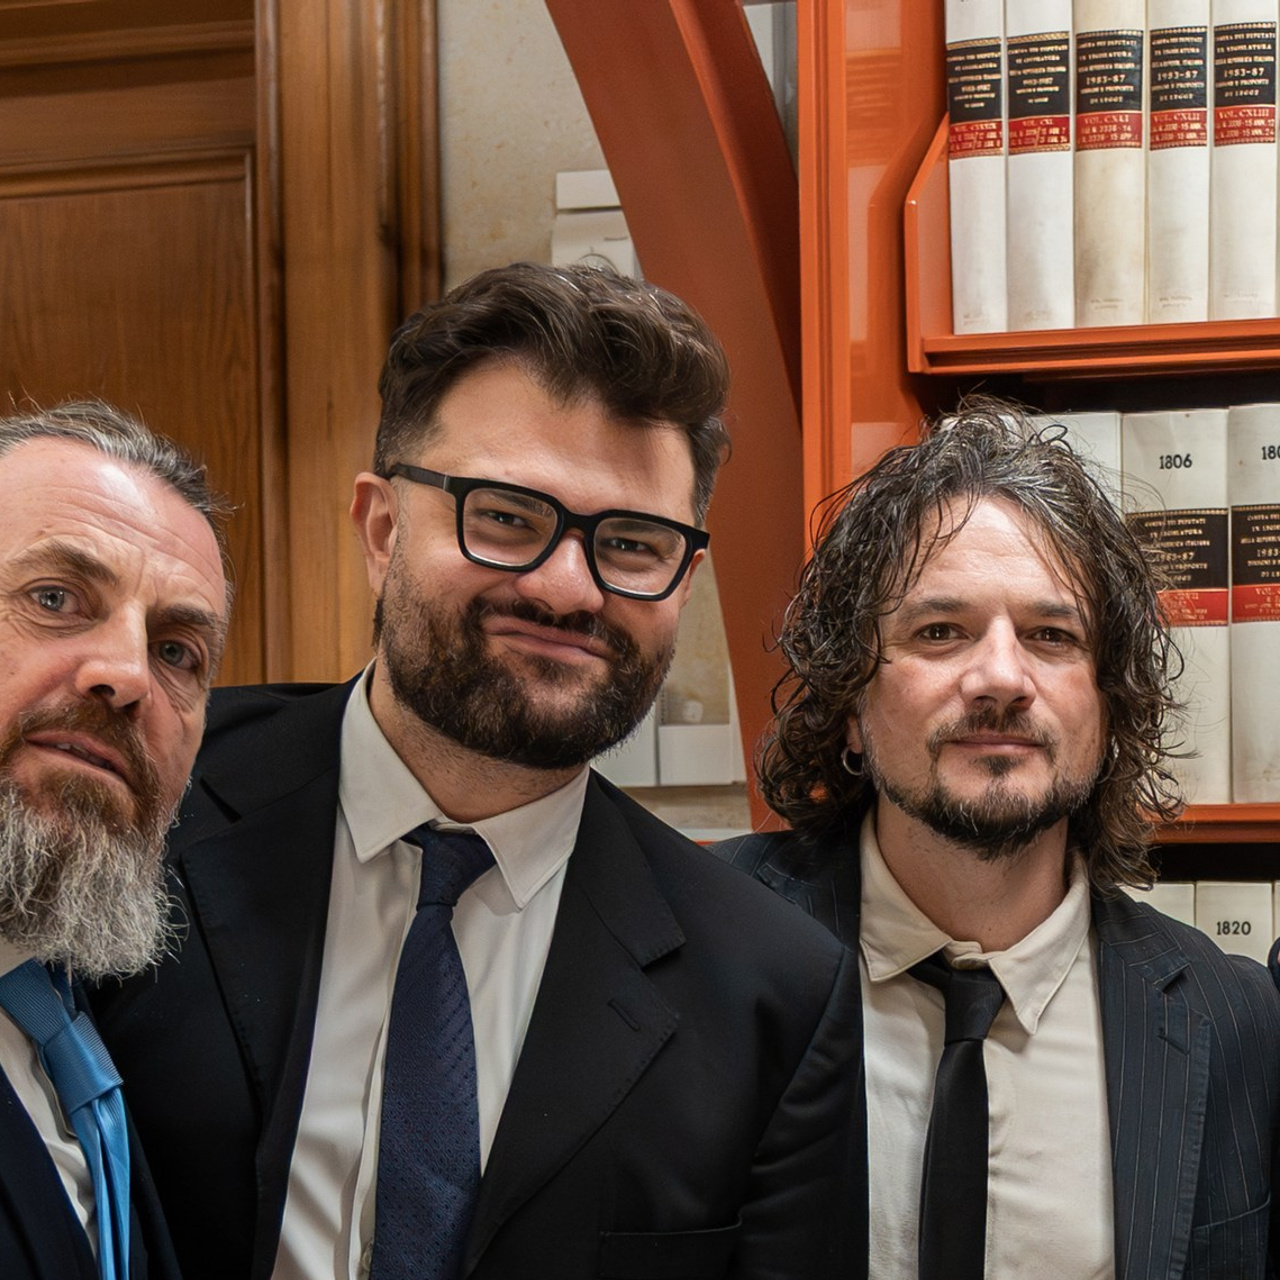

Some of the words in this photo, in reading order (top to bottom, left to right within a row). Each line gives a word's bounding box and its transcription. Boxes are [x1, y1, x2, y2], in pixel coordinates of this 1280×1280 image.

[1156, 70, 1198, 80] 1983-87
[1223, 67, 1265, 78] 1983-87
[1086, 75, 1126, 85] 1983-87
[1159, 454, 1193, 470] 1806
[1216, 921, 1252, 935] 1820
